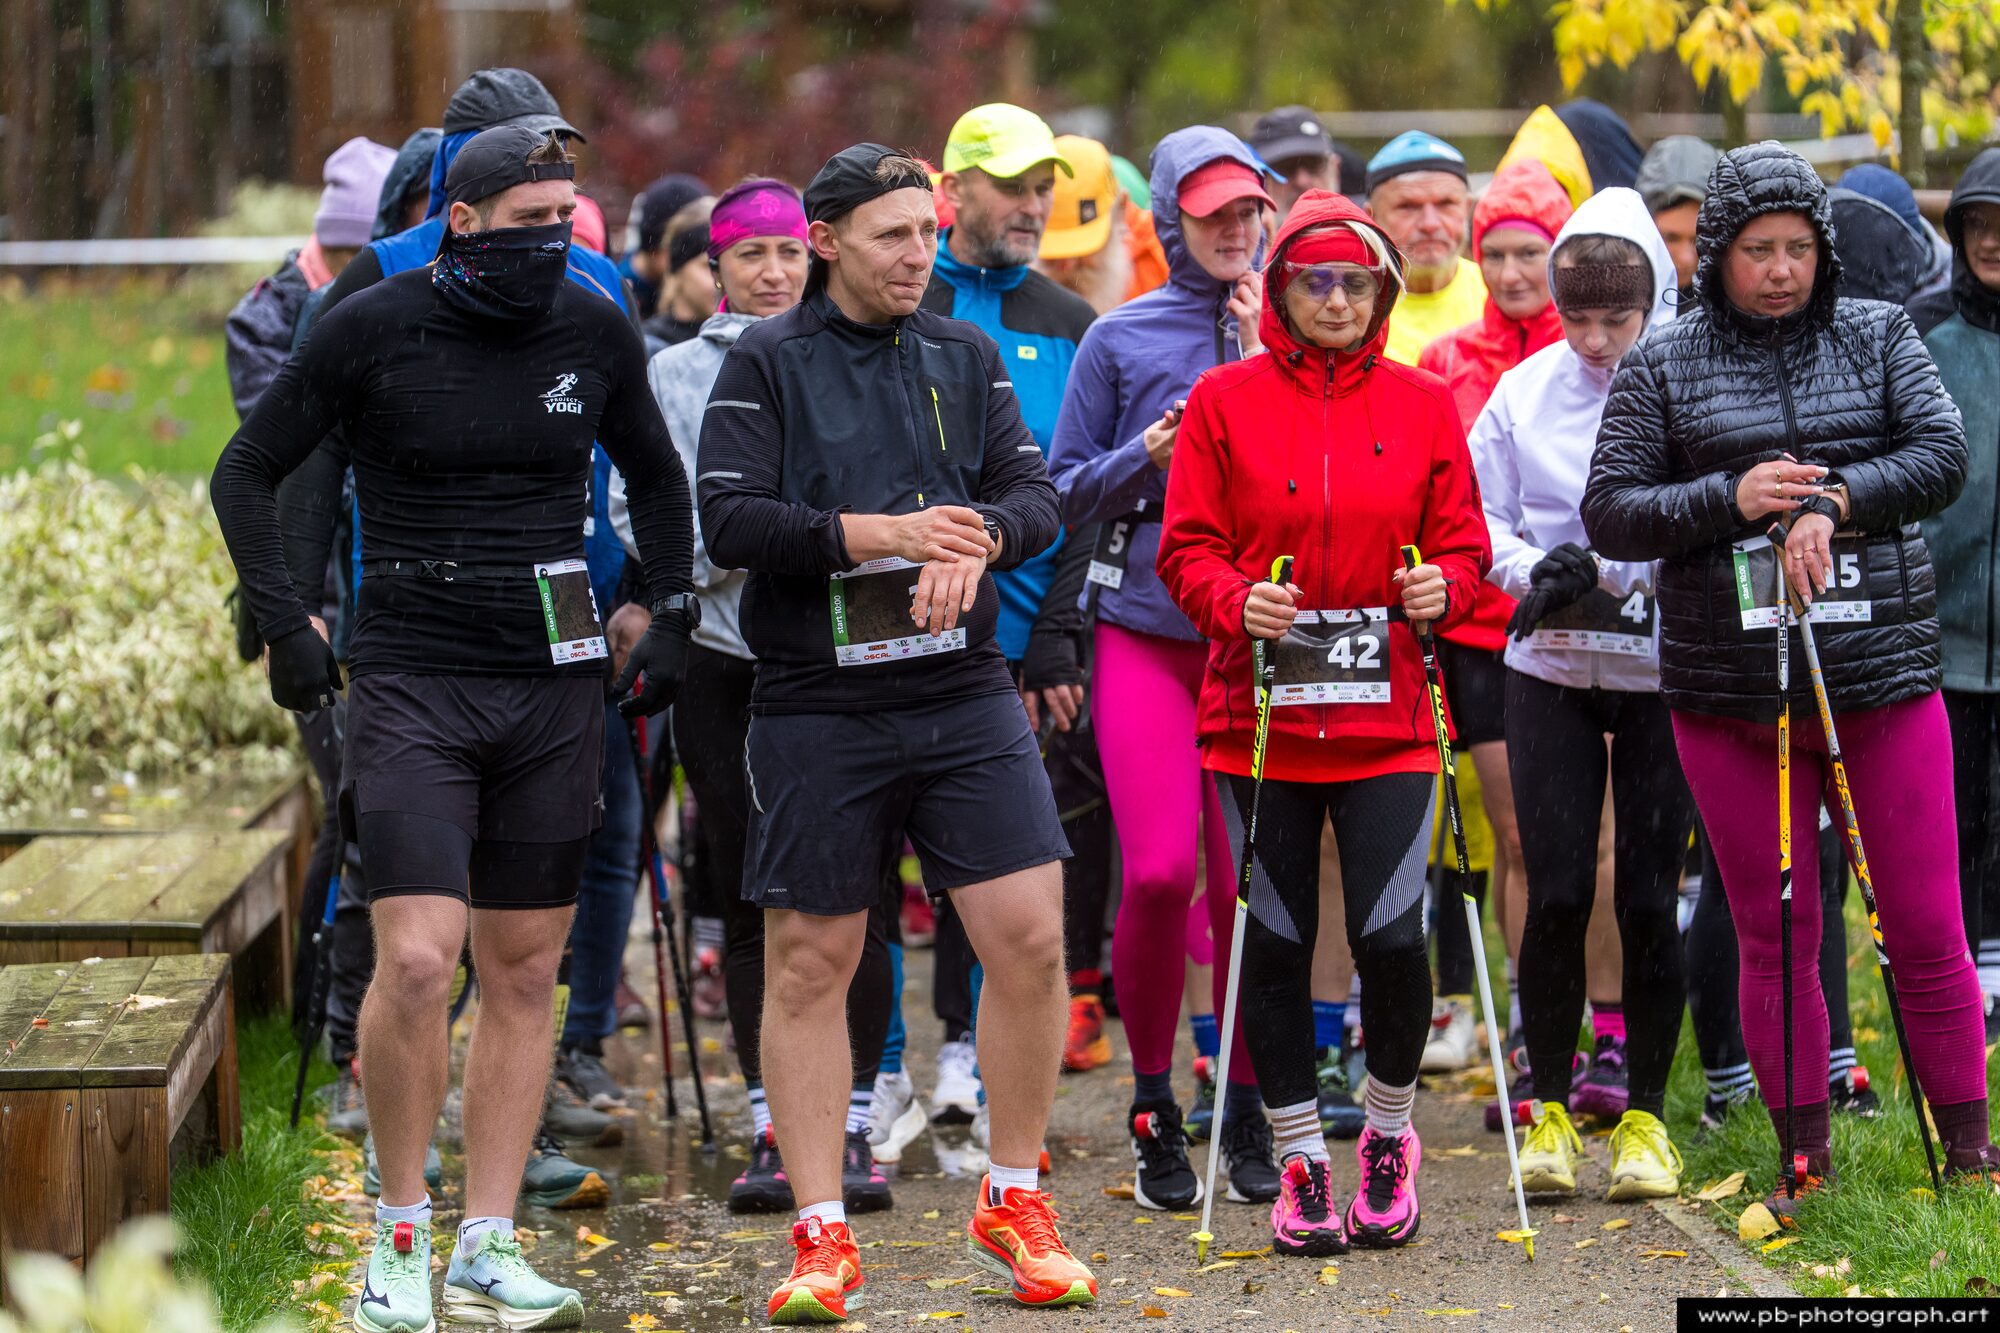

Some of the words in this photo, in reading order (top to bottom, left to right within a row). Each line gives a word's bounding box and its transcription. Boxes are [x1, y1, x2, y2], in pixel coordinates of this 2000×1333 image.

[545, 402, 583, 414] YOGI
[1738, 564, 1747, 583] 10:00
[1742, 583, 1750, 600] start
[543, 592, 552, 613] 10:00
[833, 594, 842, 615] 10:00
[548, 613, 556, 632] start
[836, 616, 845, 634] start
[863, 652, 892, 660] OSCAL
[1255, 639, 1264, 656] 10:0
[1327, 634, 1381, 669] 42
[1814, 684, 1832, 742] GABEL
[1249, 814, 1258, 844] FIZAN
[1450, 806, 1459, 835] FIZAN
[1244, 863, 1252, 882] RACE
